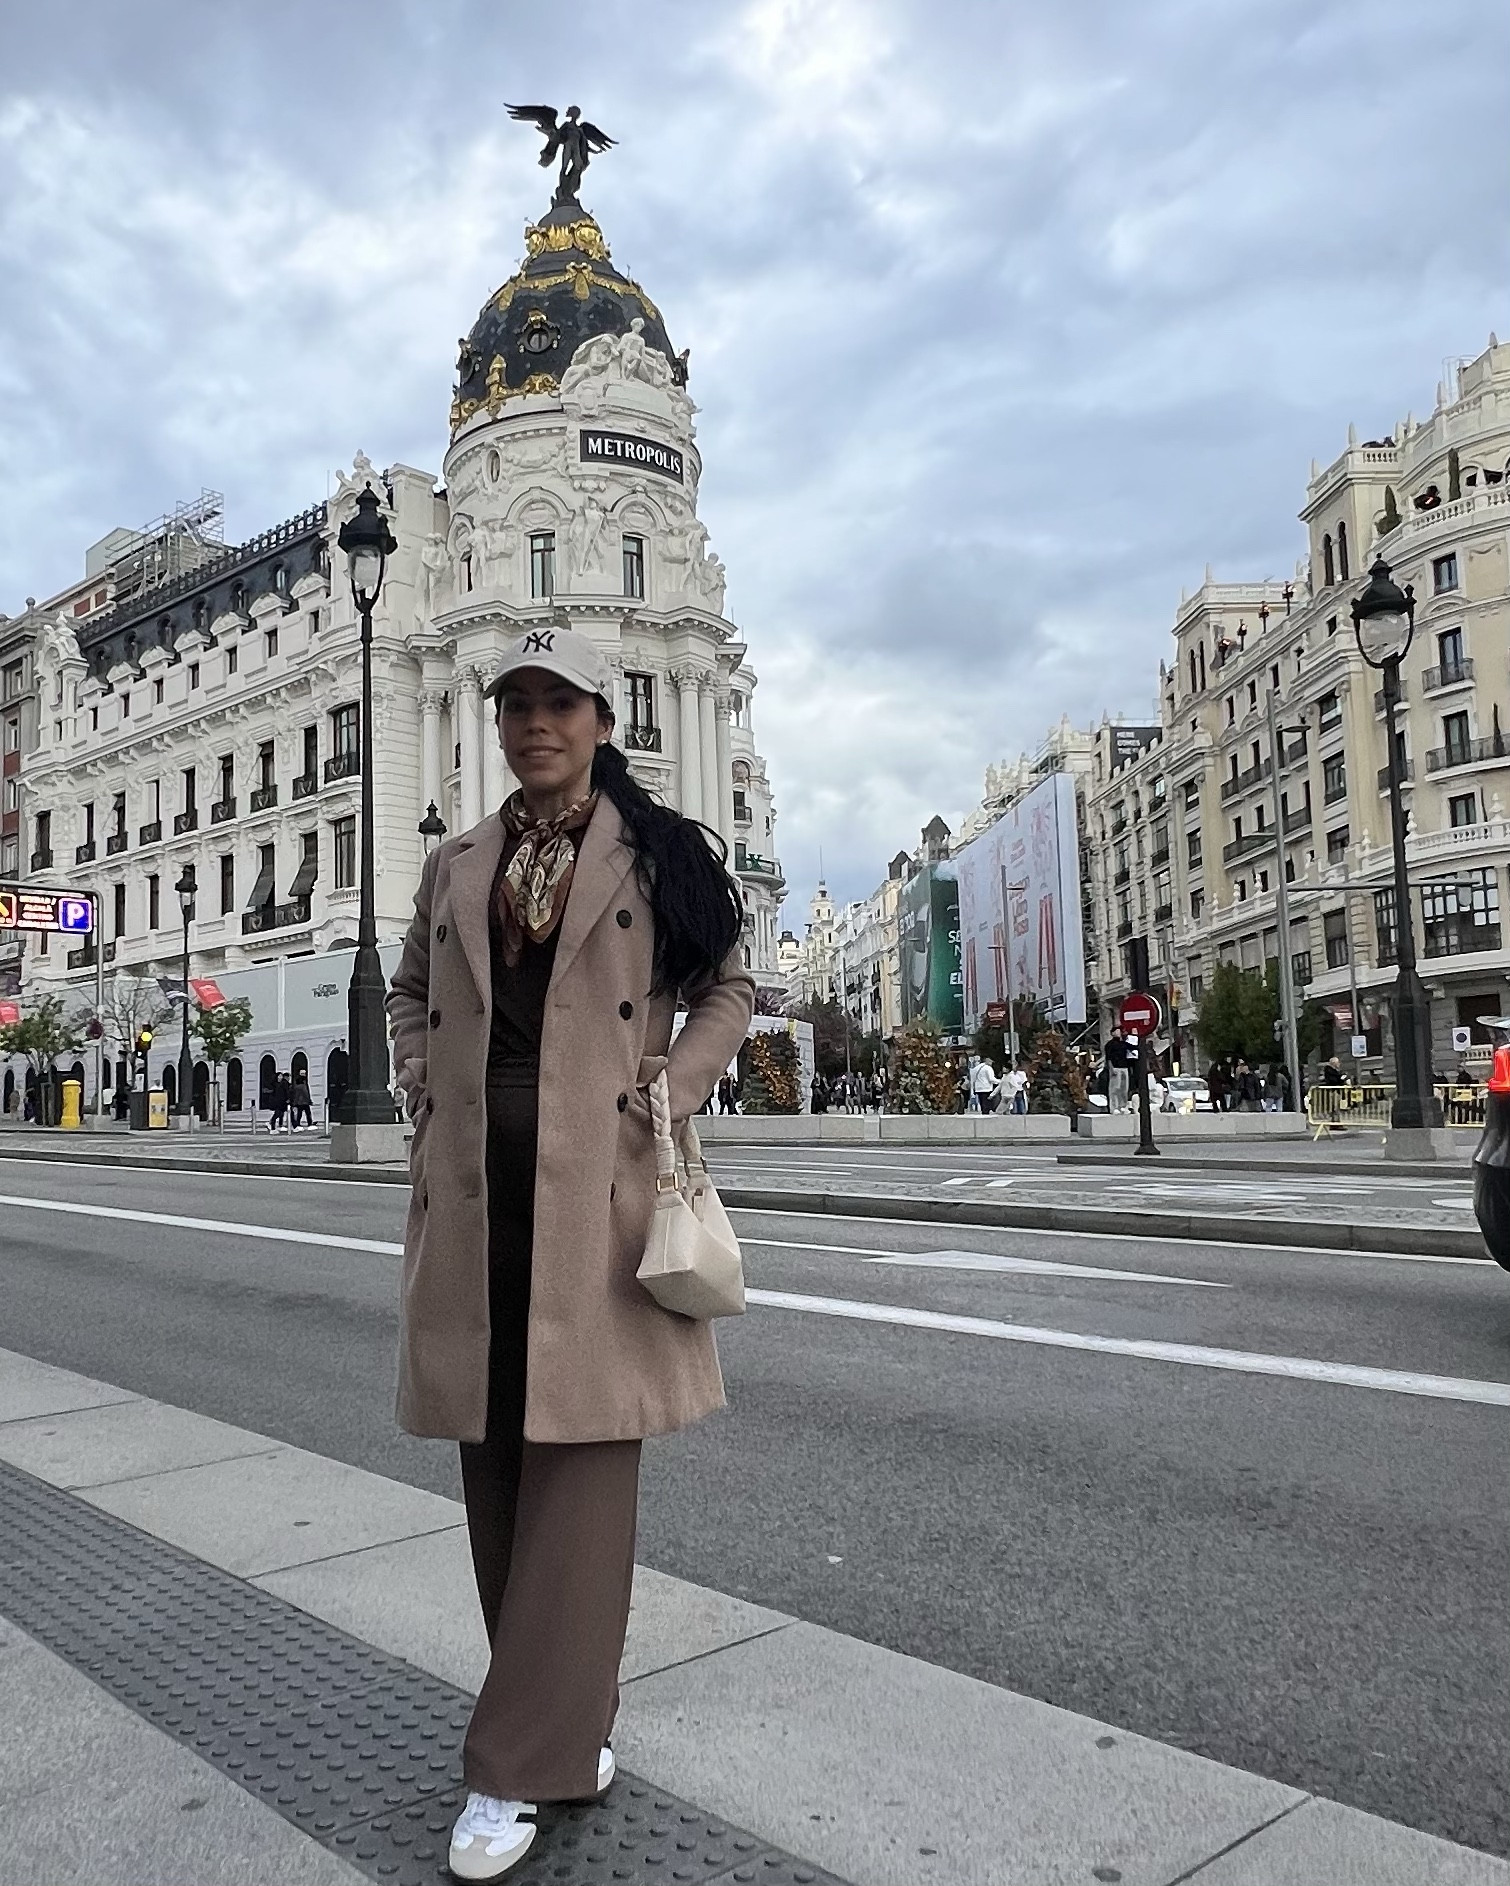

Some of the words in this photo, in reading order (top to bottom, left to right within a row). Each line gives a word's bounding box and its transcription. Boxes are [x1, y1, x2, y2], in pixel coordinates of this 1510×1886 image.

[587, 437, 681, 475] METROPOLIS
[522, 630, 555, 653] NY
[67, 903, 84, 926] P
